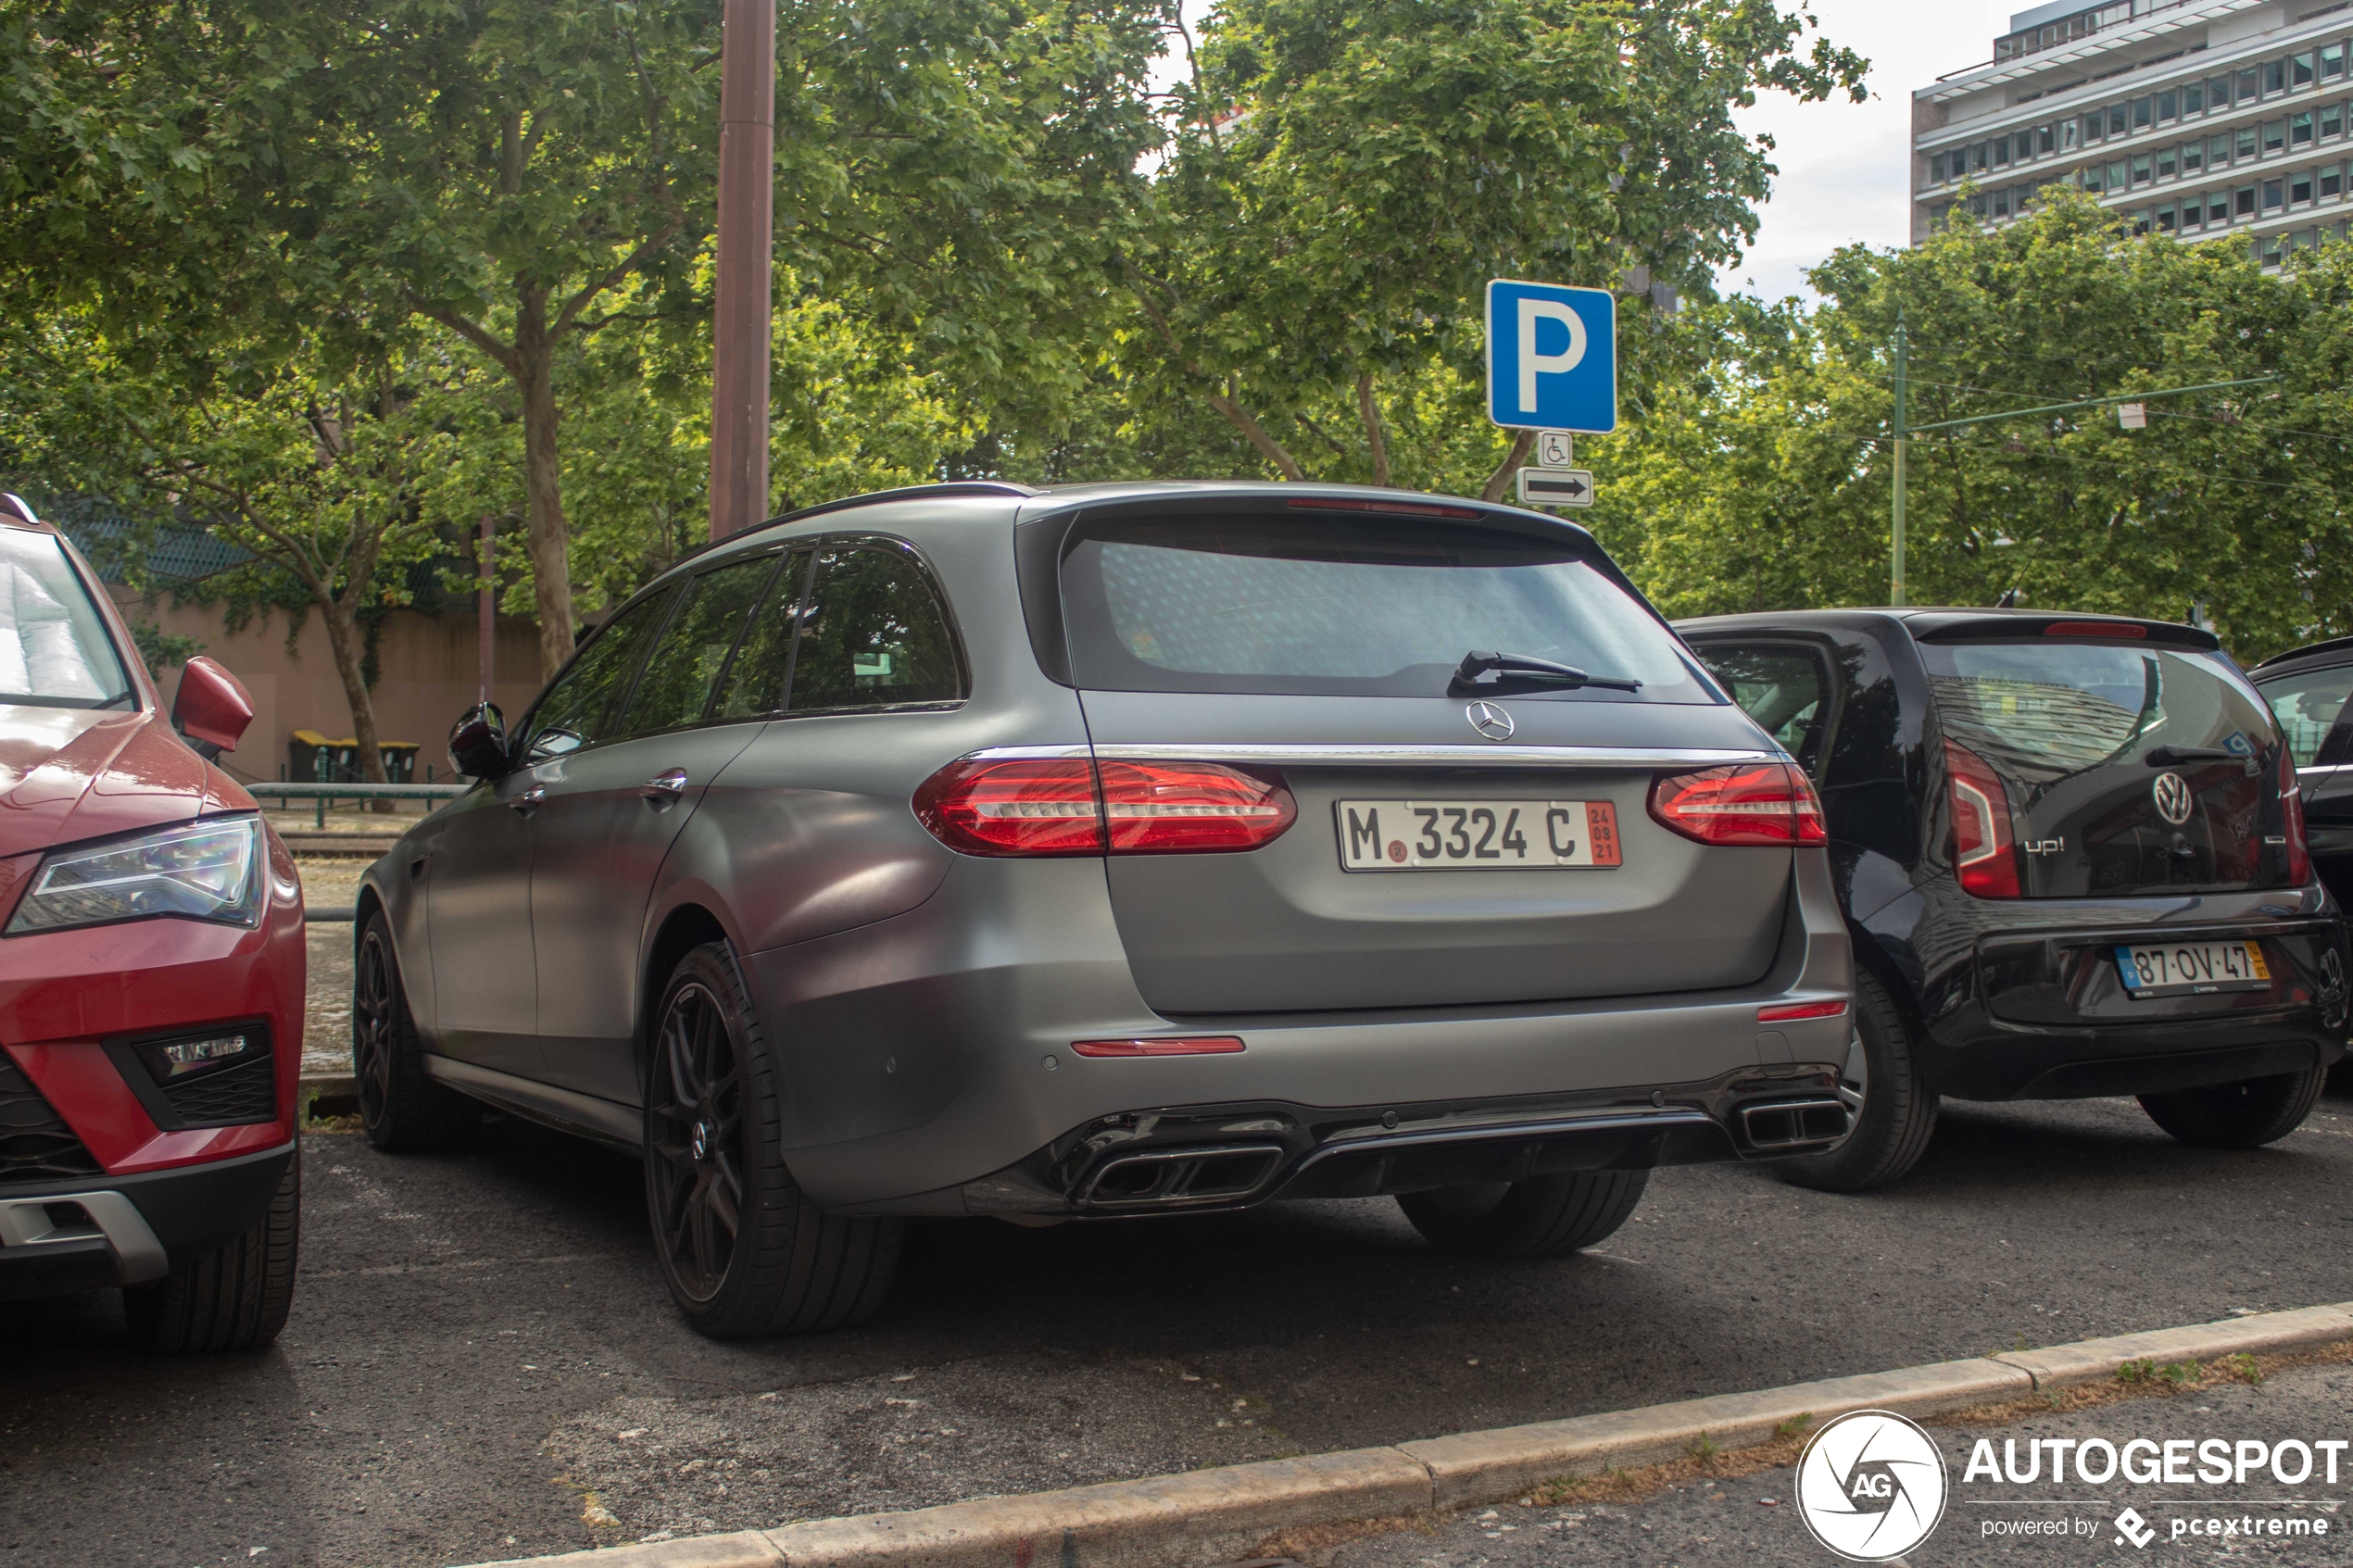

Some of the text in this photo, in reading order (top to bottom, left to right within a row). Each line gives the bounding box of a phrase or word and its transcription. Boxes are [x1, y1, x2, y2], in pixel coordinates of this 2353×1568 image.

[1517, 298, 1587, 413] P
[1591, 809, 1608, 823] 24
[1348, 808, 1382, 859] M
[1414, 808, 1527, 859] 3324
[1546, 809, 1575, 857] C
[1593, 826, 1611, 841] 08
[1596, 843, 1613, 858] 21
[2024, 836, 2065, 856] up!
